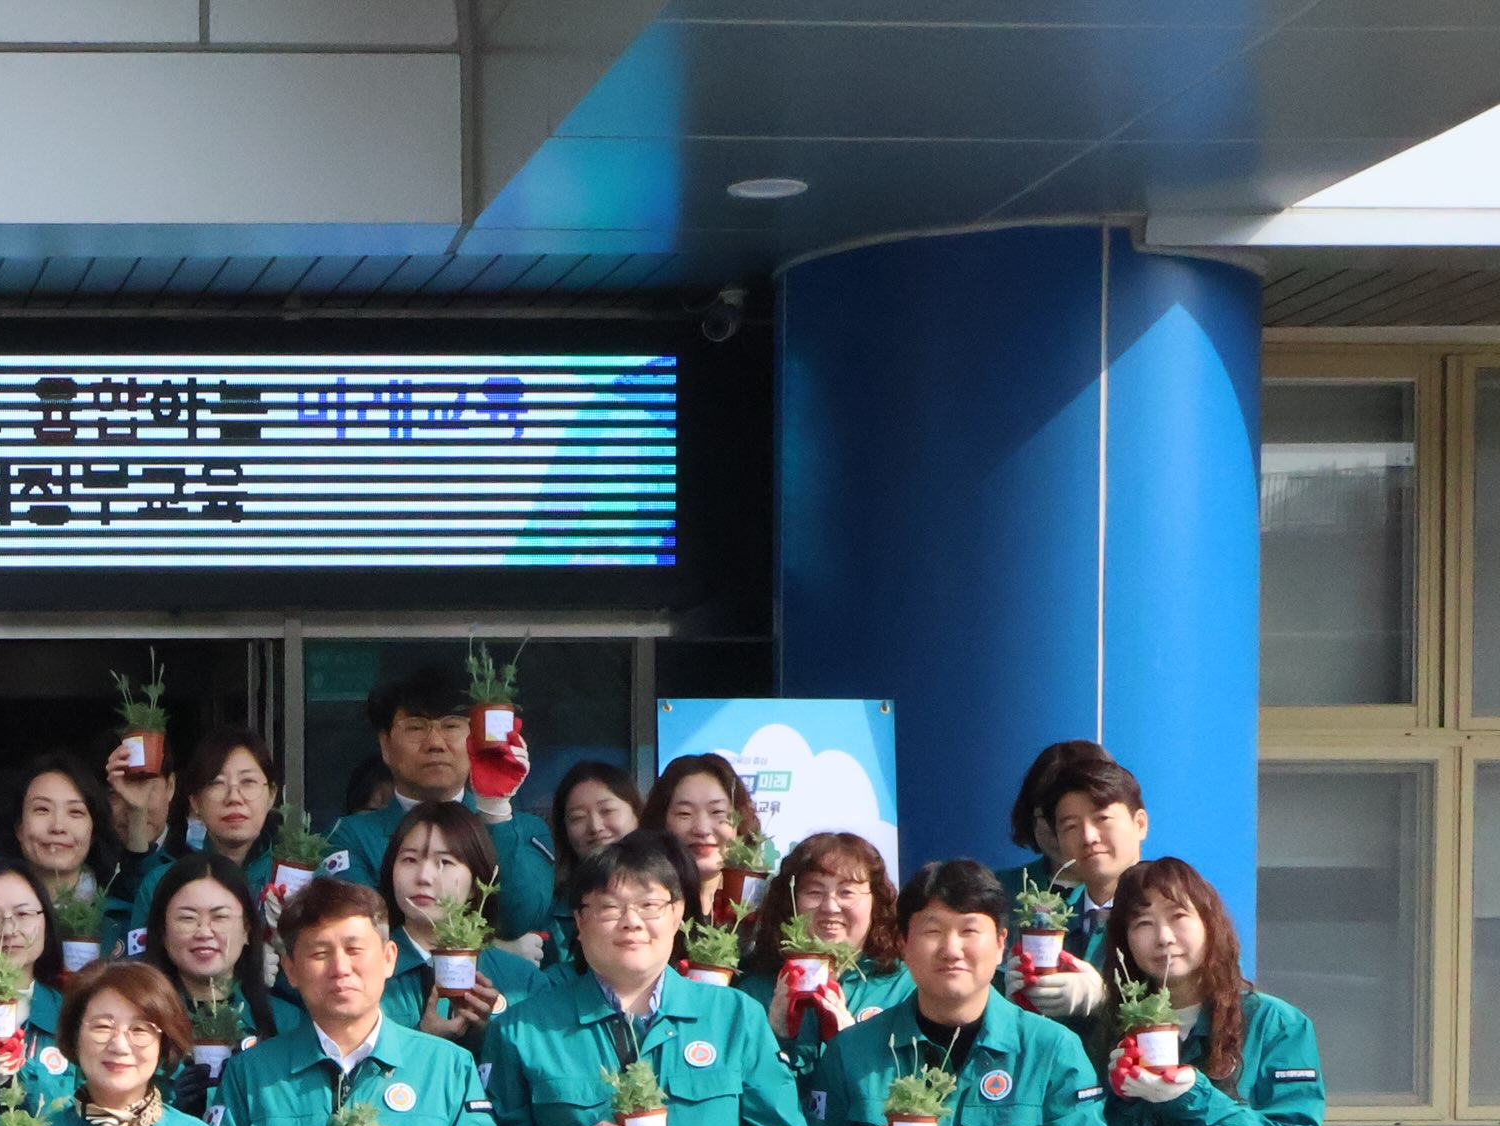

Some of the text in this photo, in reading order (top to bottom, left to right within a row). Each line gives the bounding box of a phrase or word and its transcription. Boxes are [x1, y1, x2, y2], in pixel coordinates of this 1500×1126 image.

[297, 376, 526, 439] 미래교육
[758, 773, 789, 789] 미래
[755, 800, 781, 813] 교육
